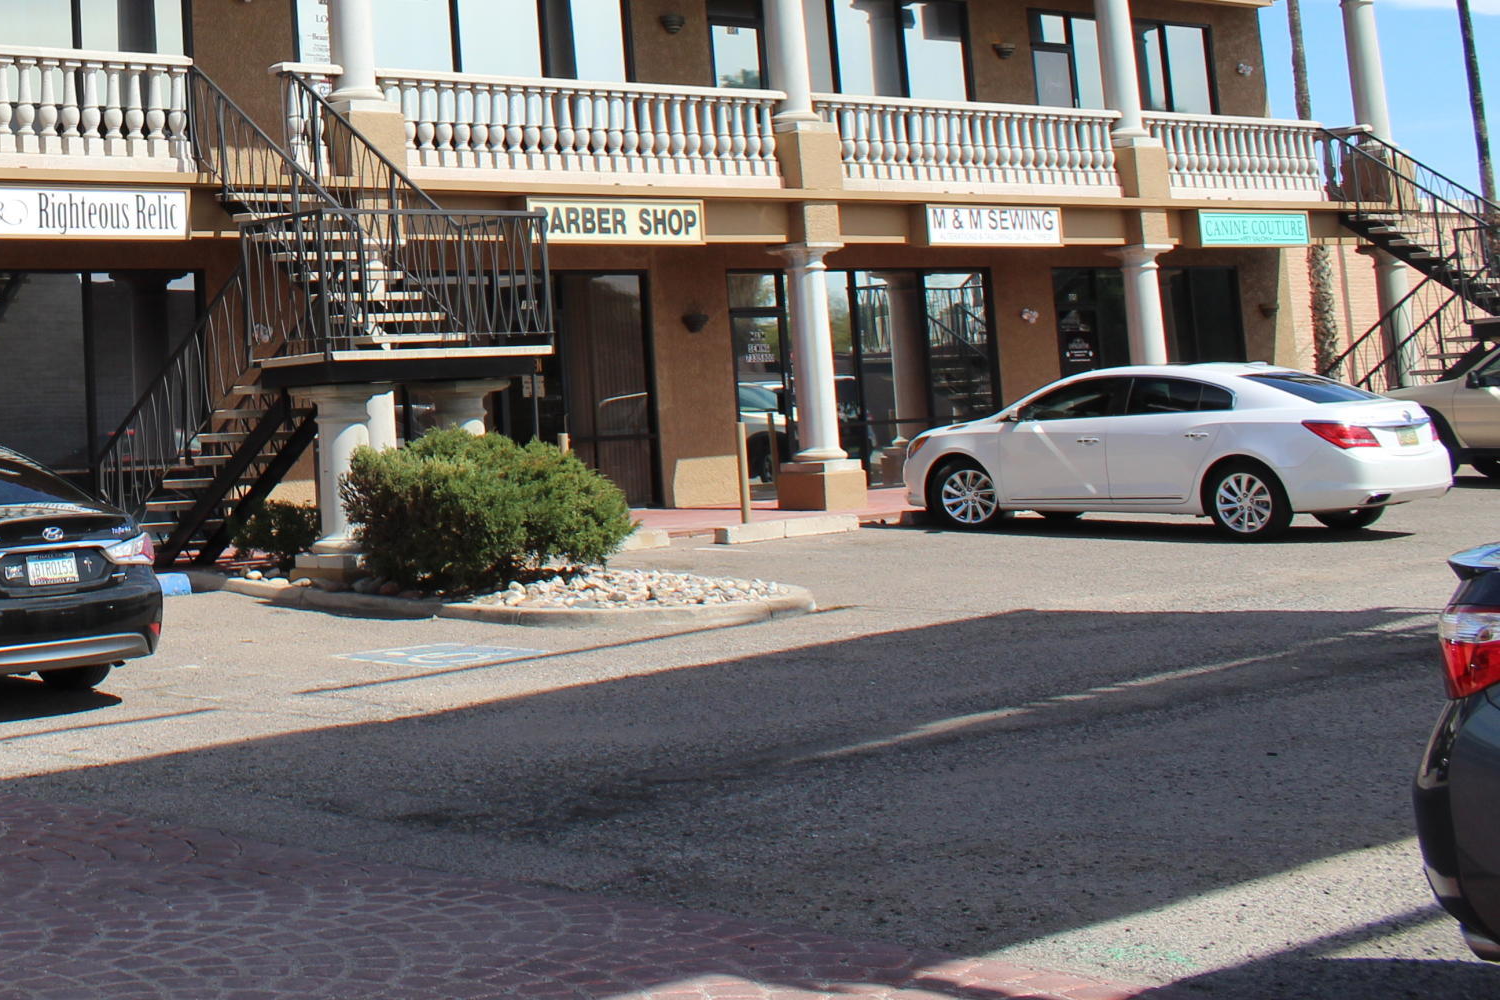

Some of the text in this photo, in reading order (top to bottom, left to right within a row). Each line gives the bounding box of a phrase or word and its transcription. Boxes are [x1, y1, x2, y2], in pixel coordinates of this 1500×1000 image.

[37, 191, 179, 235] Righteous Relic
[638, 207, 697, 236] SHOP
[933, 208, 1054, 231] M & M SEWING
[1205, 220, 1305, 237] CANINE COUTURE
